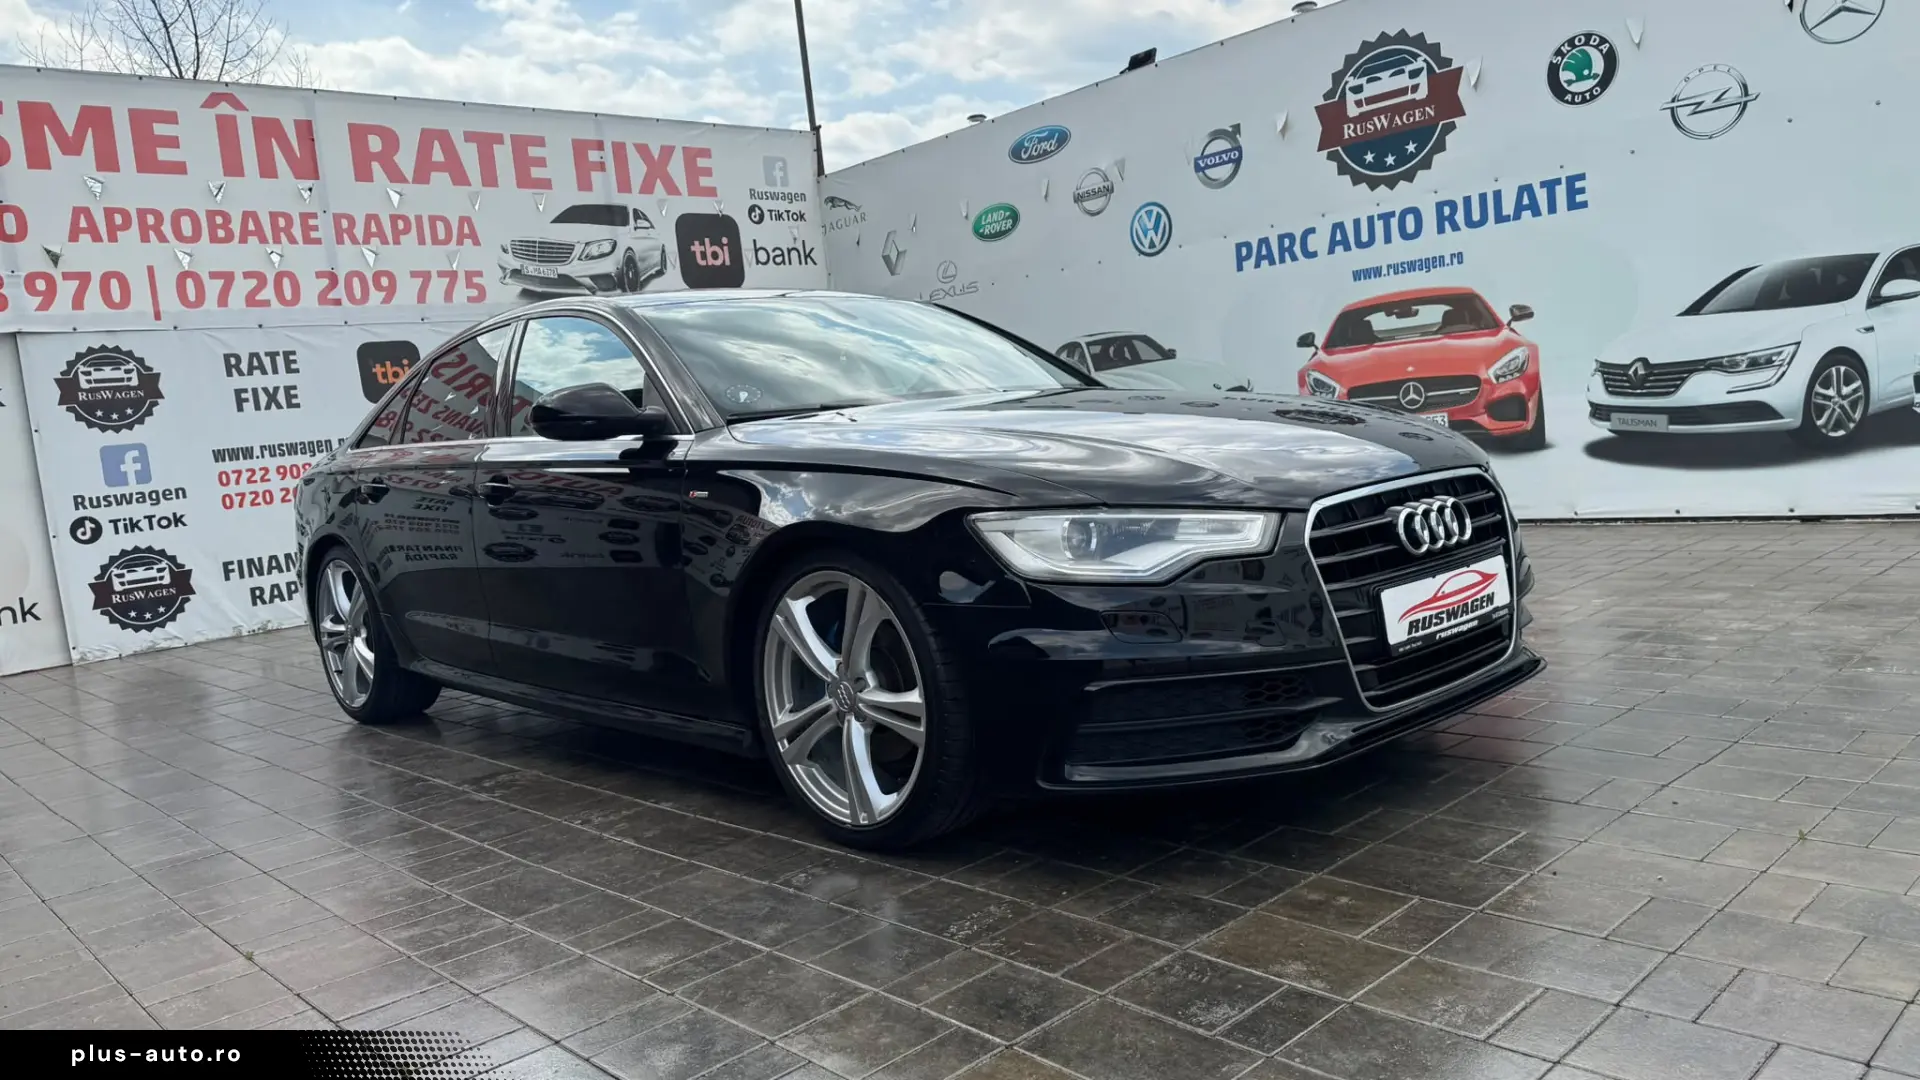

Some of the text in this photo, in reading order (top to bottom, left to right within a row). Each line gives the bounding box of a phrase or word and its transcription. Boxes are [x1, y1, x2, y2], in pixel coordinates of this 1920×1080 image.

[1564, 87, 1602, 103] AUTO
[0, 92, 718, 198] ME ÎN RATE FIXE
[1021, 131, 1059, 159] Ford
[1198, 150, 1239, 168] VOLVO
[749, 188, 807, 204] Ruswagen
[1077, 184, 1110, 200] NISSAN
[68, 206, 323, 245] APROBARE
[332, 213, 482, 246] RAPIDA
[767, 210, 807, 223] TikTok
[821, 211, 867, 236] JAGUAR
[981, 210, 1004, 224] LAND
[984, 219, 1013, 235] ROVER
[1235, 172, 1589, 272] PARC AUTO RULATE
[690, 237, 818, 266] tbi bank
[1352, 252, 1464, 282] www.ruswagen.ro
[23, 270, 131, 312] 970
[175, 270, 301, 310] 0720
[315, 270, 397, 307] 209
[409, 269, 487, 305] 775
[223, 350, 300, 377] RATE
[233, 385, 301, 413] FIXE
[1616, 417, 1657, 427] TALISMAN
[217, 467, 271, 487] 0722
[73, 487, 187, 511] Ruswagen
[221, 490, 274, 510] 0720
[109, 512, 188, 535] TikTok
[1407, 592, 1495, 636] RUSWAGEN
